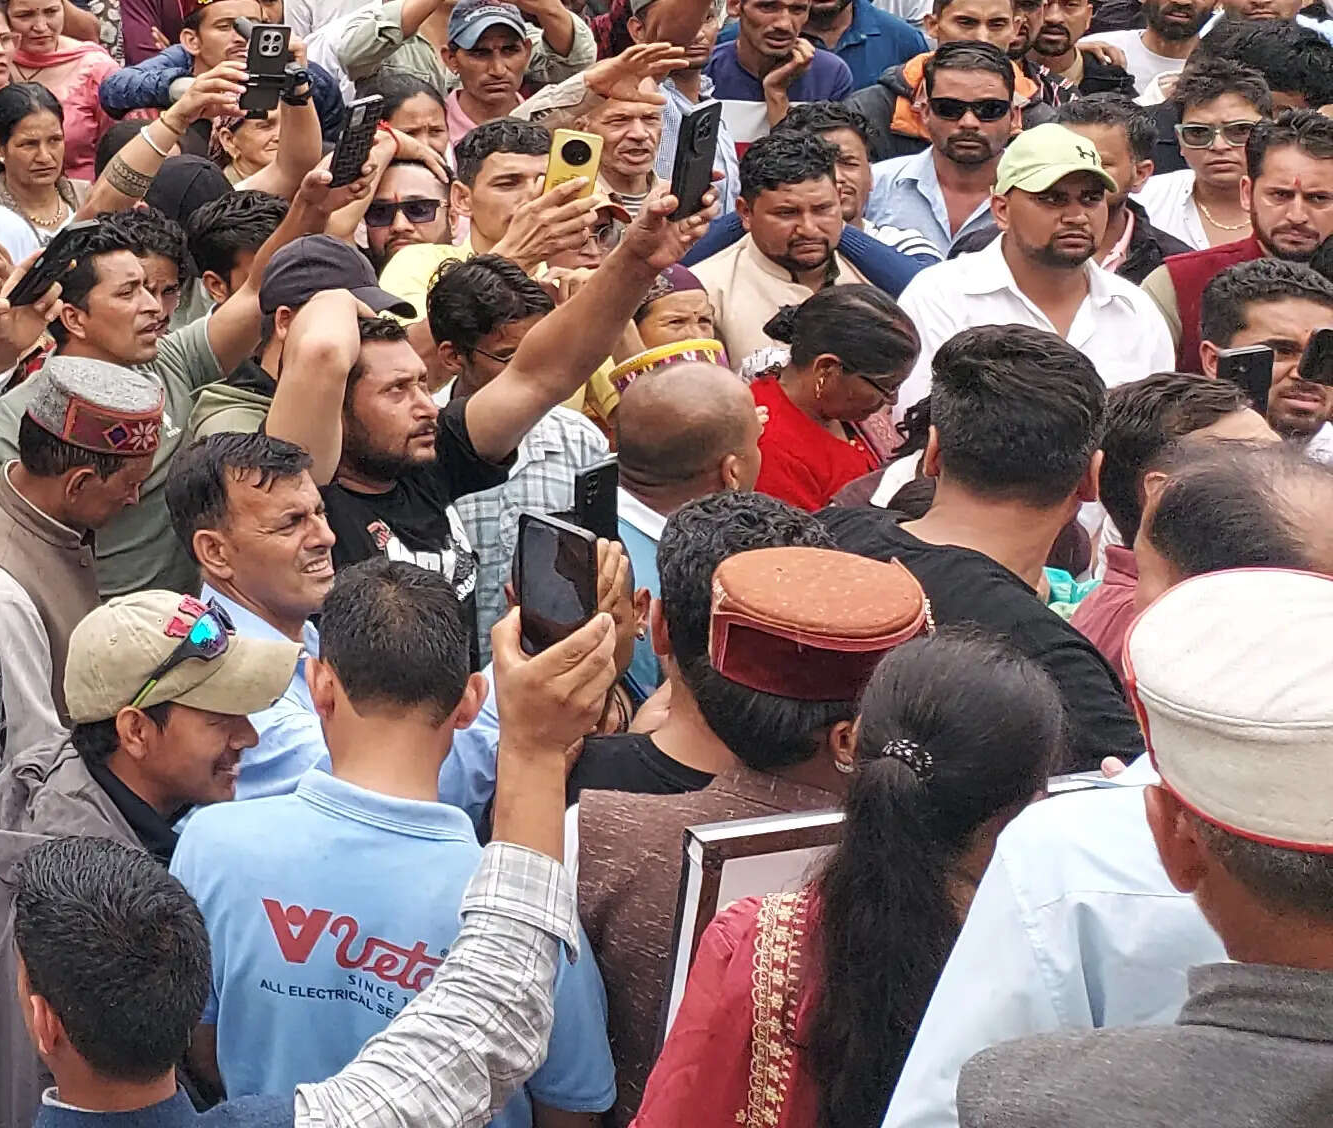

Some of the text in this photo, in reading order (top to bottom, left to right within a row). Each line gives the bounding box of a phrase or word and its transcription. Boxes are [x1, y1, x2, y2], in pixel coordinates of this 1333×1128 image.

[259, 978, 285, 995] ALL
[288, 985, 374, 1011] ELECTRICAL
[348, 974, 395, 1004] SINCE
